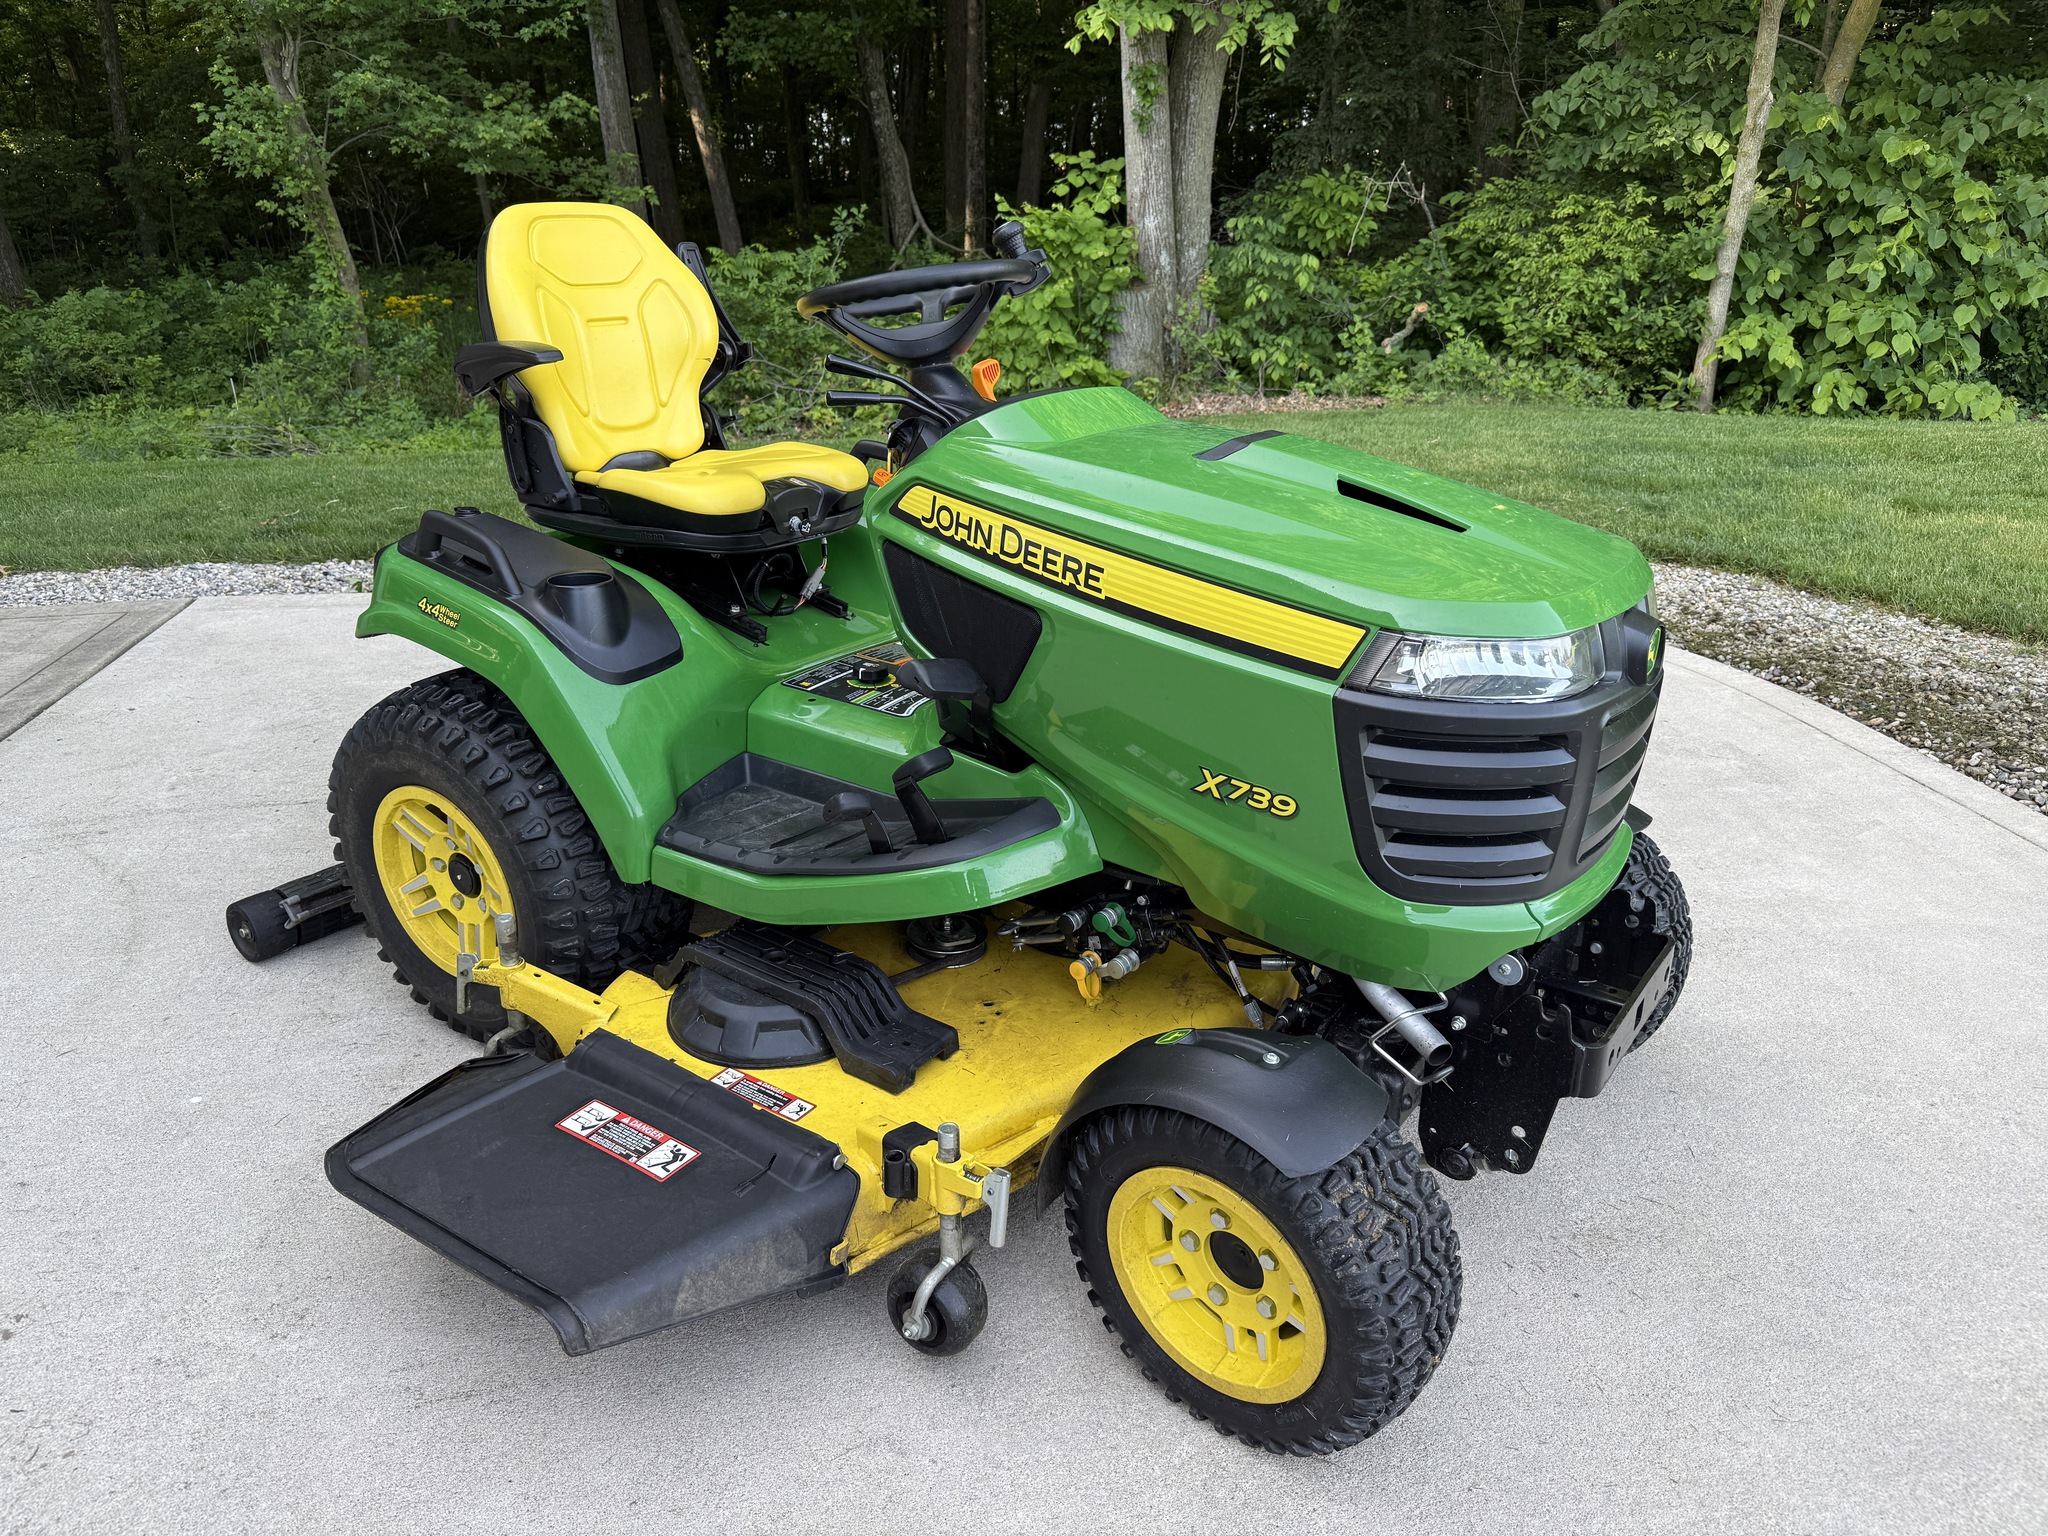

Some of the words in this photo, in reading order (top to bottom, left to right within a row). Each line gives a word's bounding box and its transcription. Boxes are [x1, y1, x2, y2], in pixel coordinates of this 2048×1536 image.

[921, 495, 993, 551] JOHN
[1000, 524, 1105, 595] DEERE
[418, 597, 440, 617] 4x4
[440, 604, 461, 620] Wheel
[437, 613, 458, 628] Steer
[1192, 766, 1298, 817] X739
[762, 1082, 786, 1096] DANGER
[629, 1119, 665, 1140] DANGER
